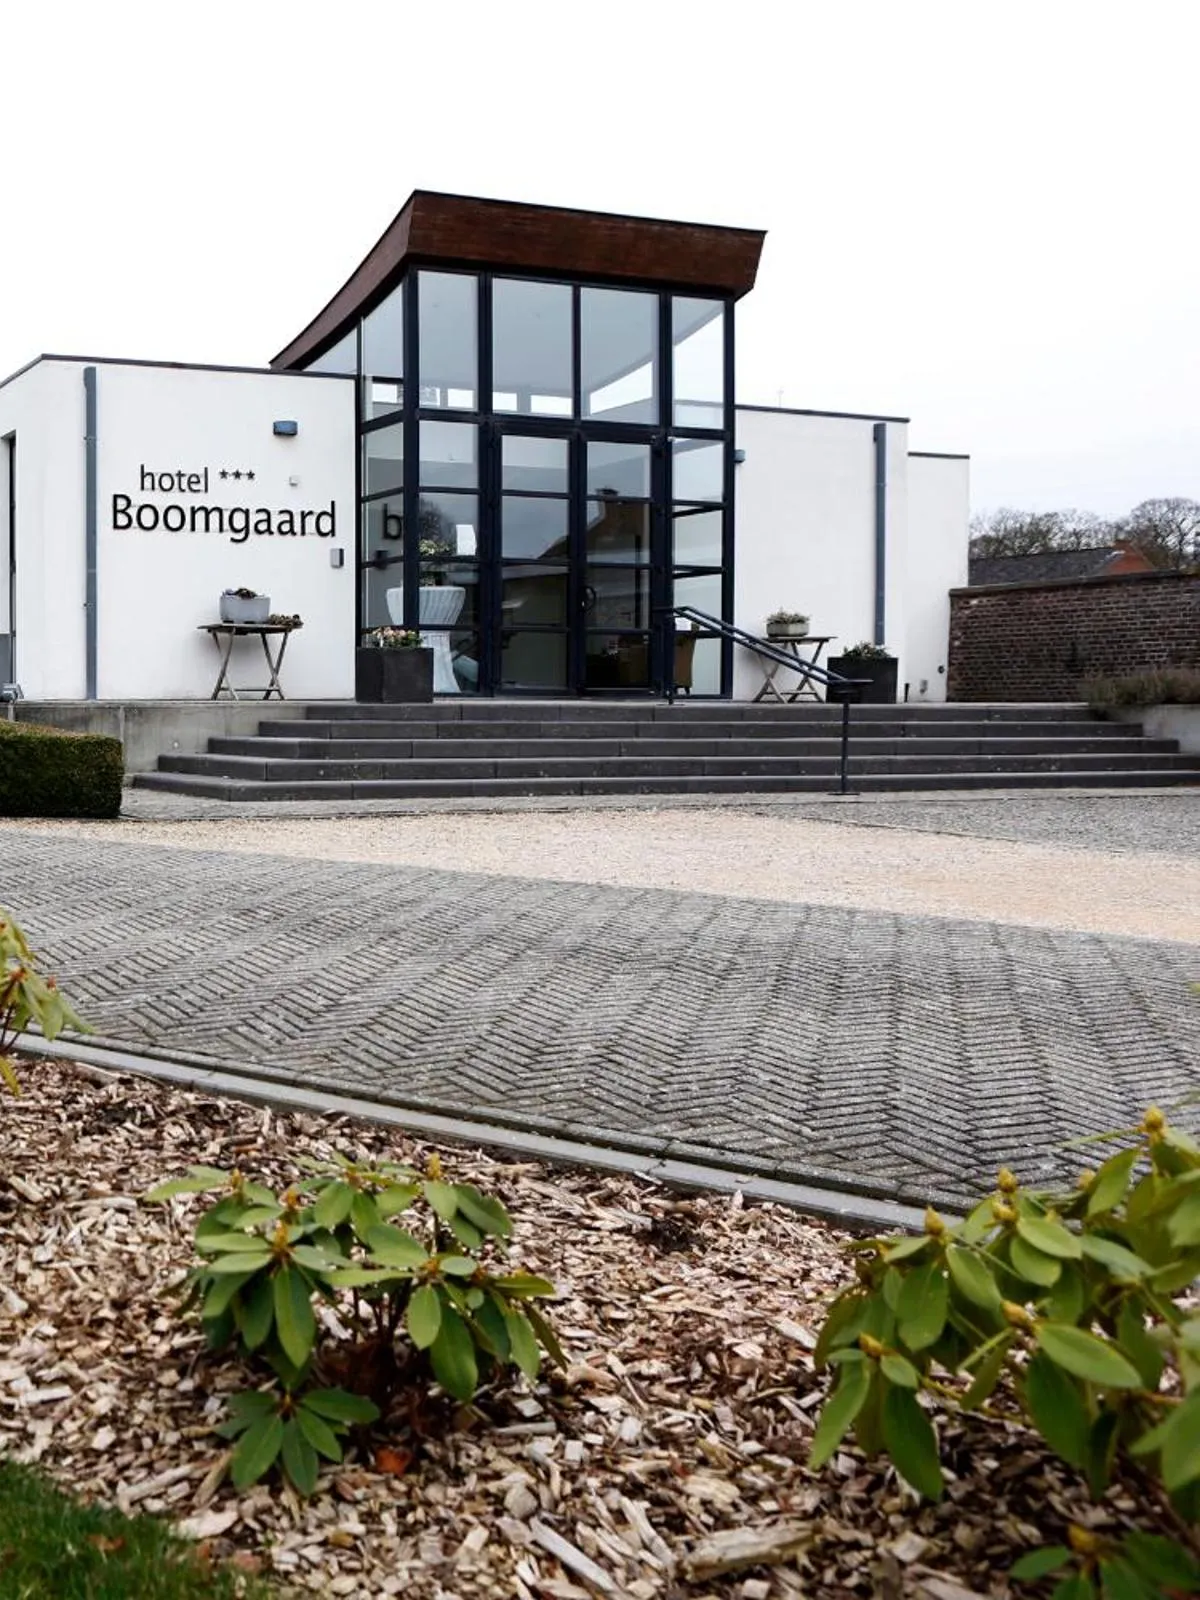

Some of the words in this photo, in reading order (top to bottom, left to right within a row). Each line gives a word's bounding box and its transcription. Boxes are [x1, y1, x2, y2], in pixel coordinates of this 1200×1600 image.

[139, 463, 209, 493] hotel
[111, 493, 336, 543] Boomgaard
[383, 503, 402, 540] b
